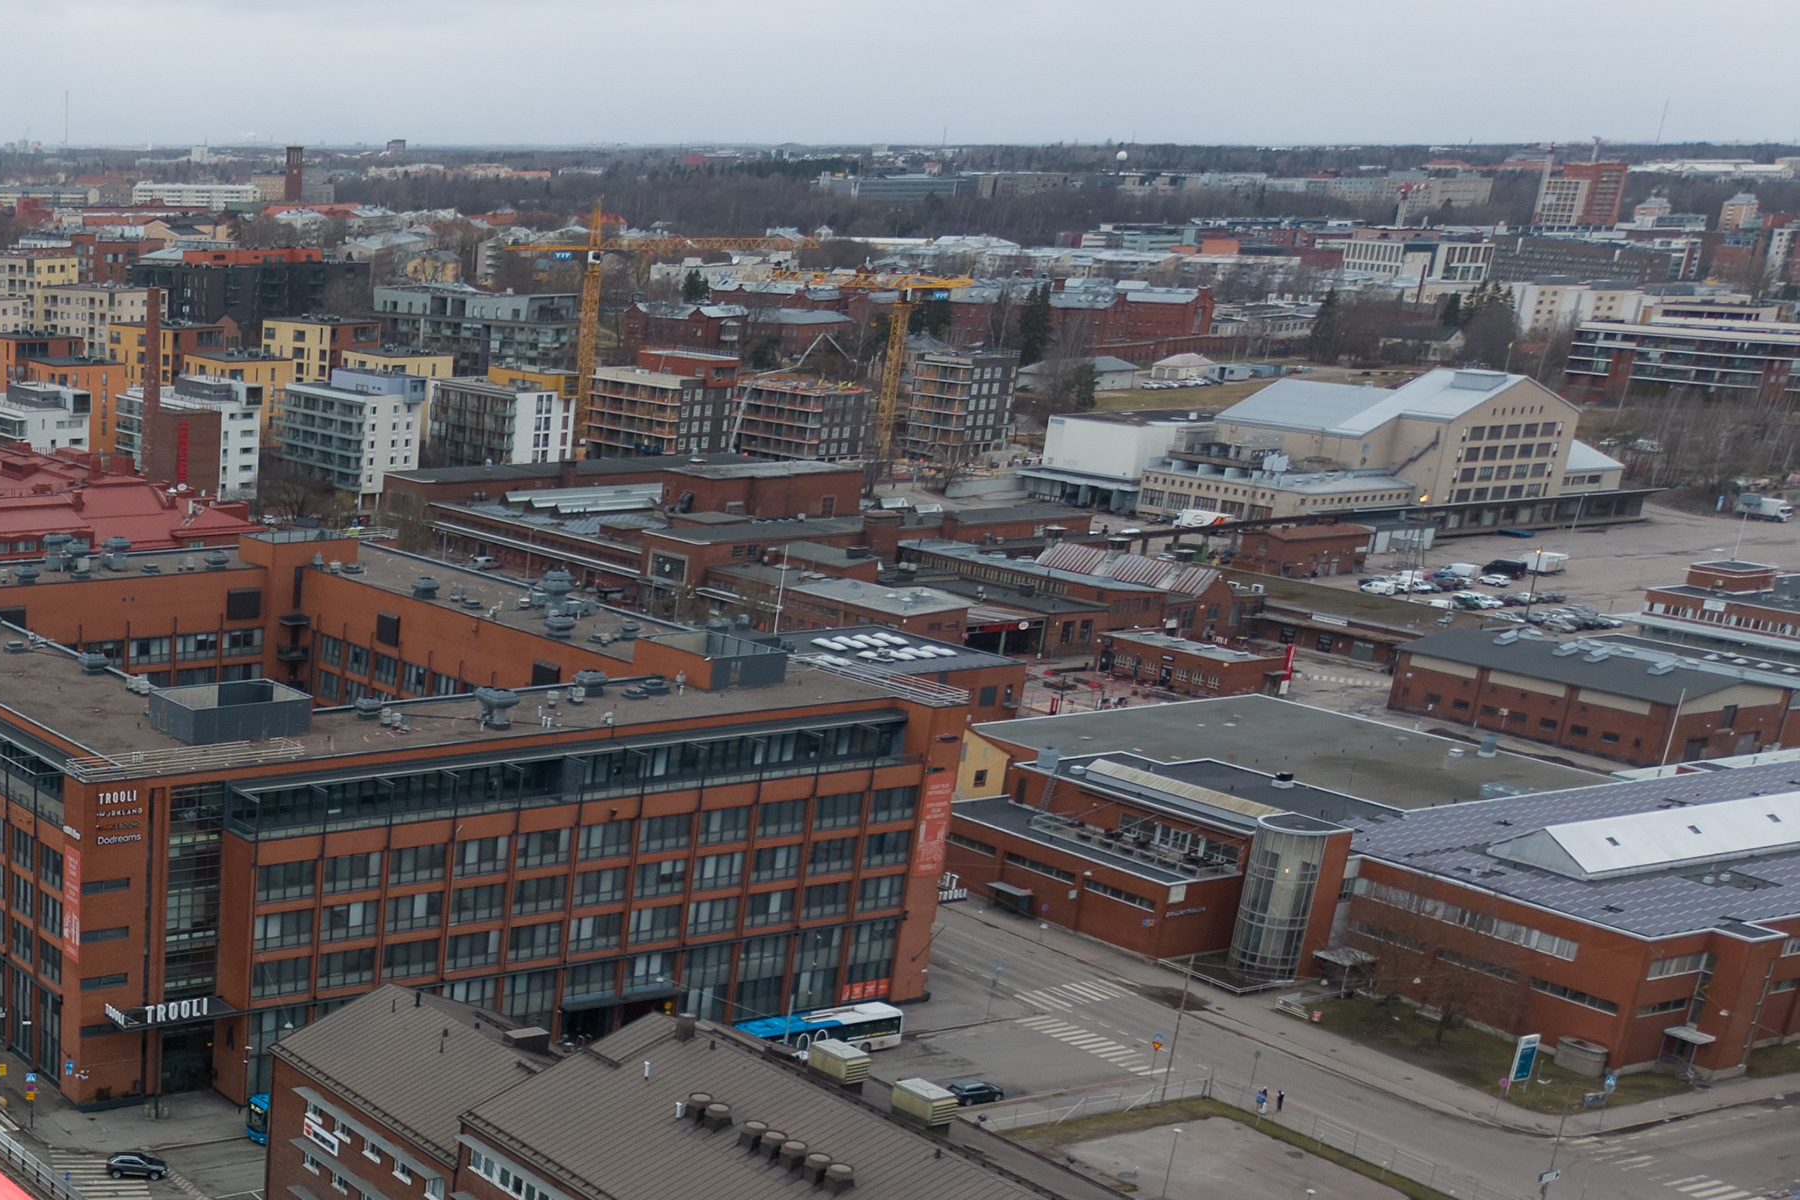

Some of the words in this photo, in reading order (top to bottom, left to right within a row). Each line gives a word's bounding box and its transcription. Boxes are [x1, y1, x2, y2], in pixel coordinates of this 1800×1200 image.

[98, 790, 137, 805] TROOLI
[97, 834, 142, 845] Dodreams
[938, 888, 967, 901] TROOLI
[145, 997, 208, 1024] TROOLI
